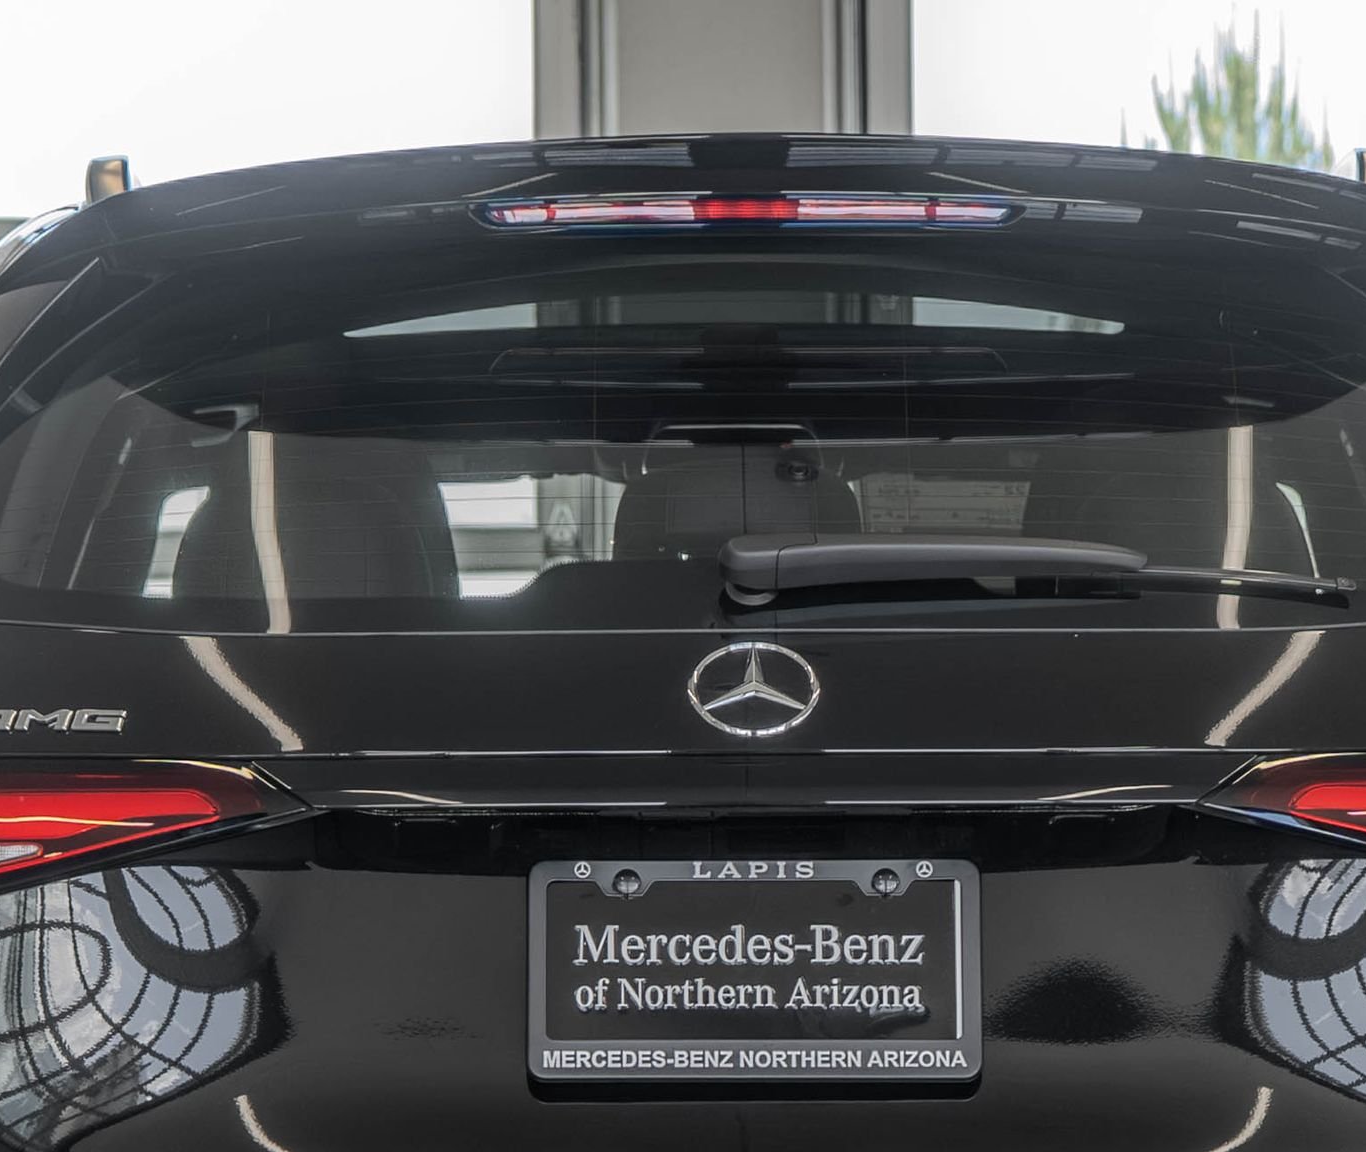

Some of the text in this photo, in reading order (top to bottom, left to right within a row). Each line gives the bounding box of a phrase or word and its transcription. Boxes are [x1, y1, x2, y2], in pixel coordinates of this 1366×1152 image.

[692, 861, 816, 879] LAPIS
[573, 924, 926, 966] Mercedes-Benz
[575, 978, 926, 1010] of Northern Arizona
[542, 1050, 968, 1069] MERCEDES-BENZ NORTHERN ARIZONA
